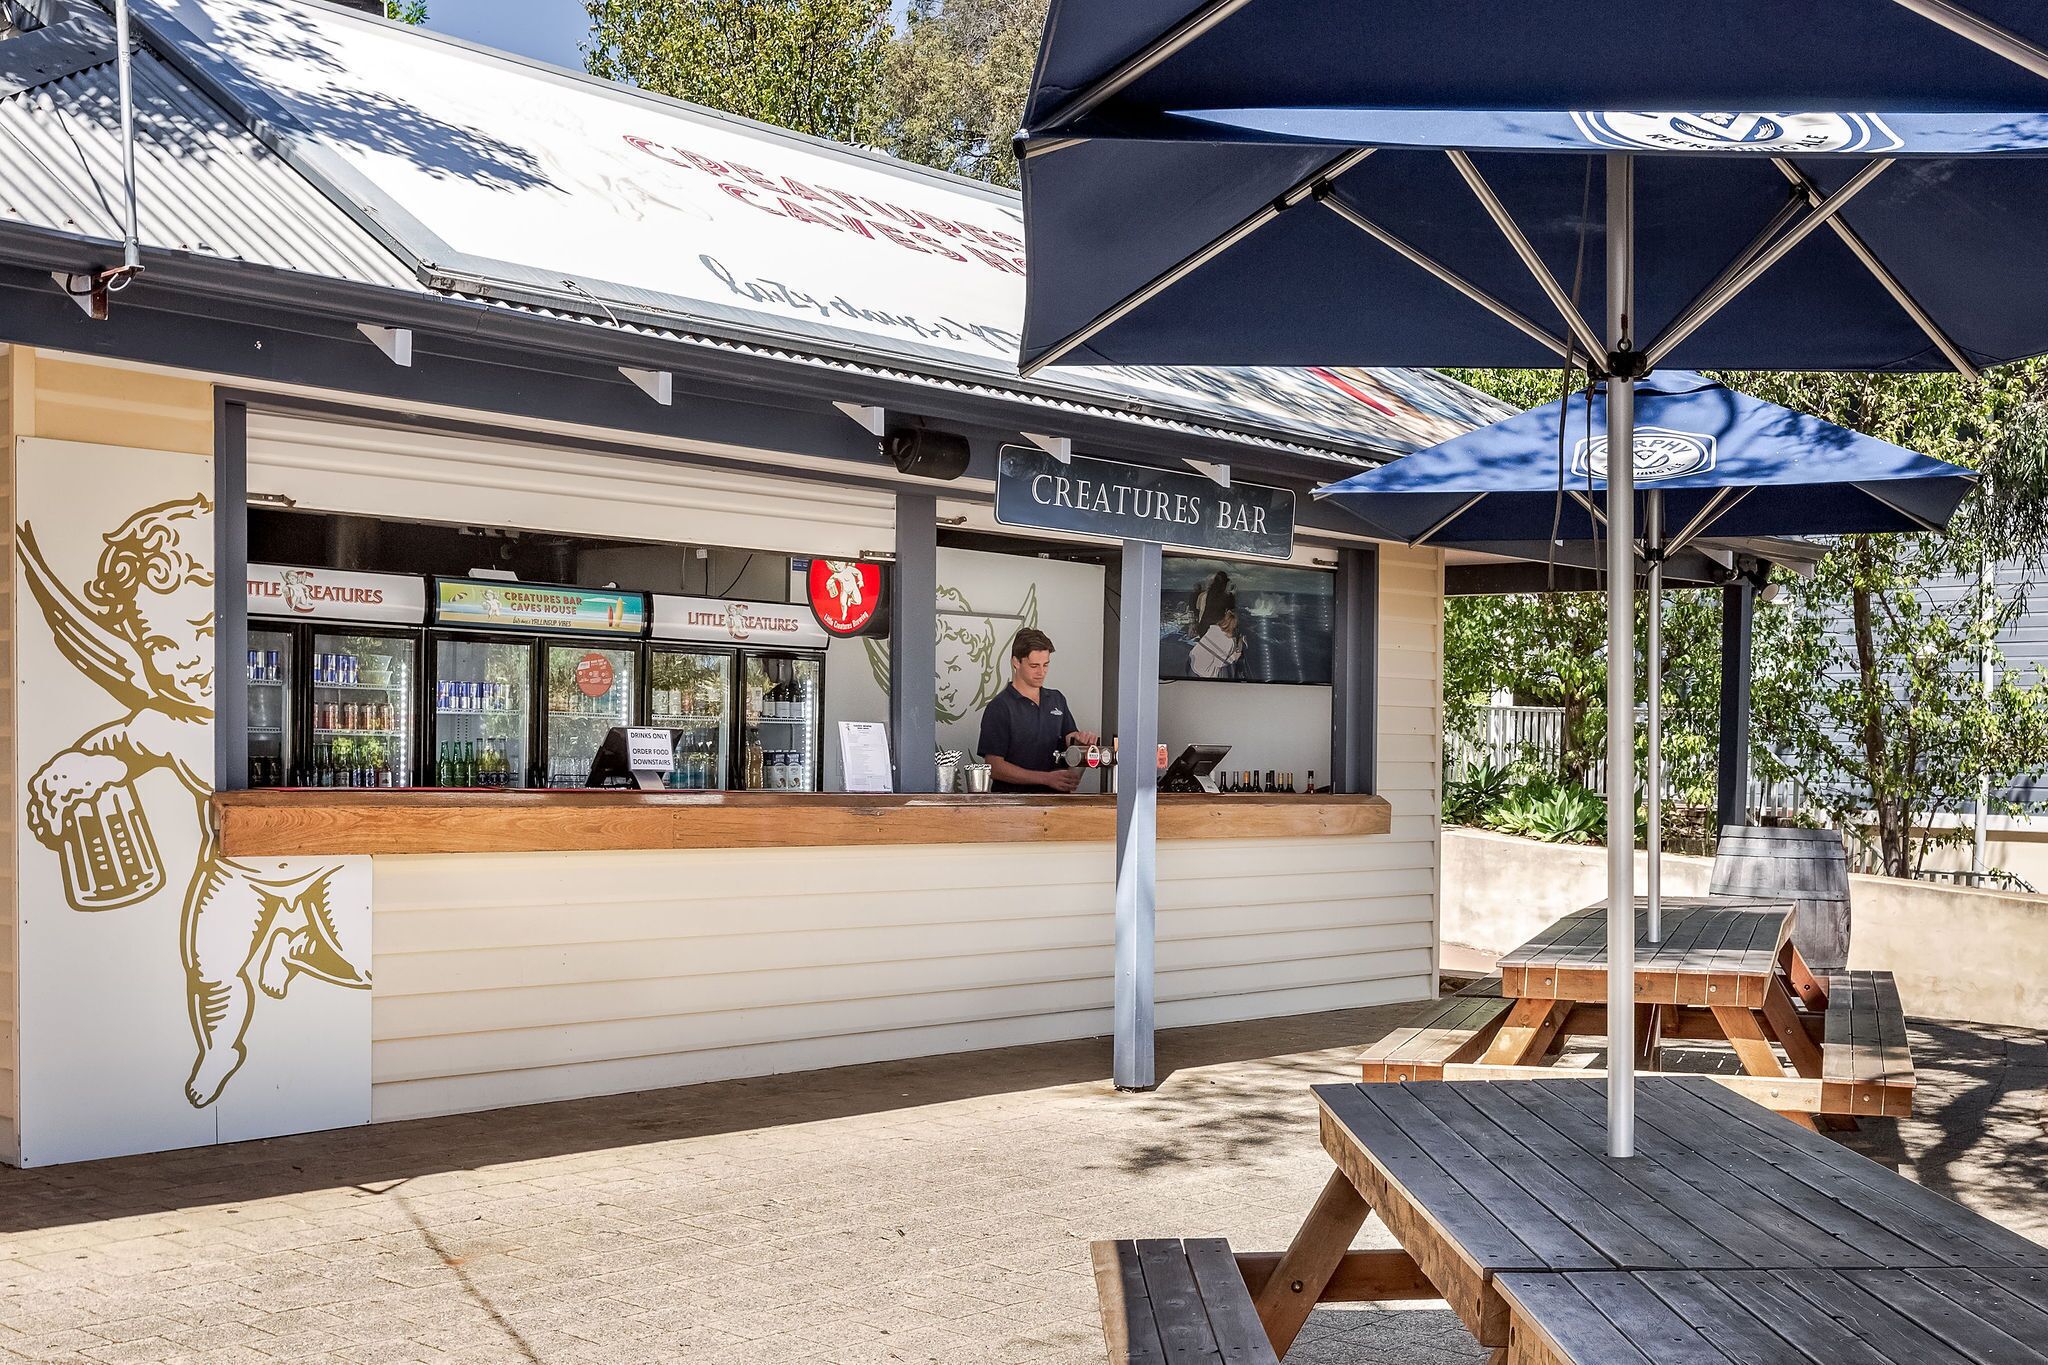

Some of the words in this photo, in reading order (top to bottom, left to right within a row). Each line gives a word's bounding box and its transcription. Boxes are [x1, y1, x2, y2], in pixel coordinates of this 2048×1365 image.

[1796, 134, 1828, 148] ALE
[622, 135, 1024, 253] CREATURES
[717, 182, 968, 263] CAVES
[1031, 474, 1201, 526] CREATURES
[1216, 501, 1268, 535] BAR
[247, 580, 282, 597] TTLE
[280, 570, 383, 613] CREATURES
[504, 592, 561, 604] CREATURES
[562, 596, 582, 606] BAR
[511, 603, 542, 612] CAVES
[544, 605, 577, 614] HOUSE
[688, 611, 726, 627] LITTLE
[727, 604, 799, 640] CREATURES
[633, 758, 671, 766] DOWNSTAIRS
